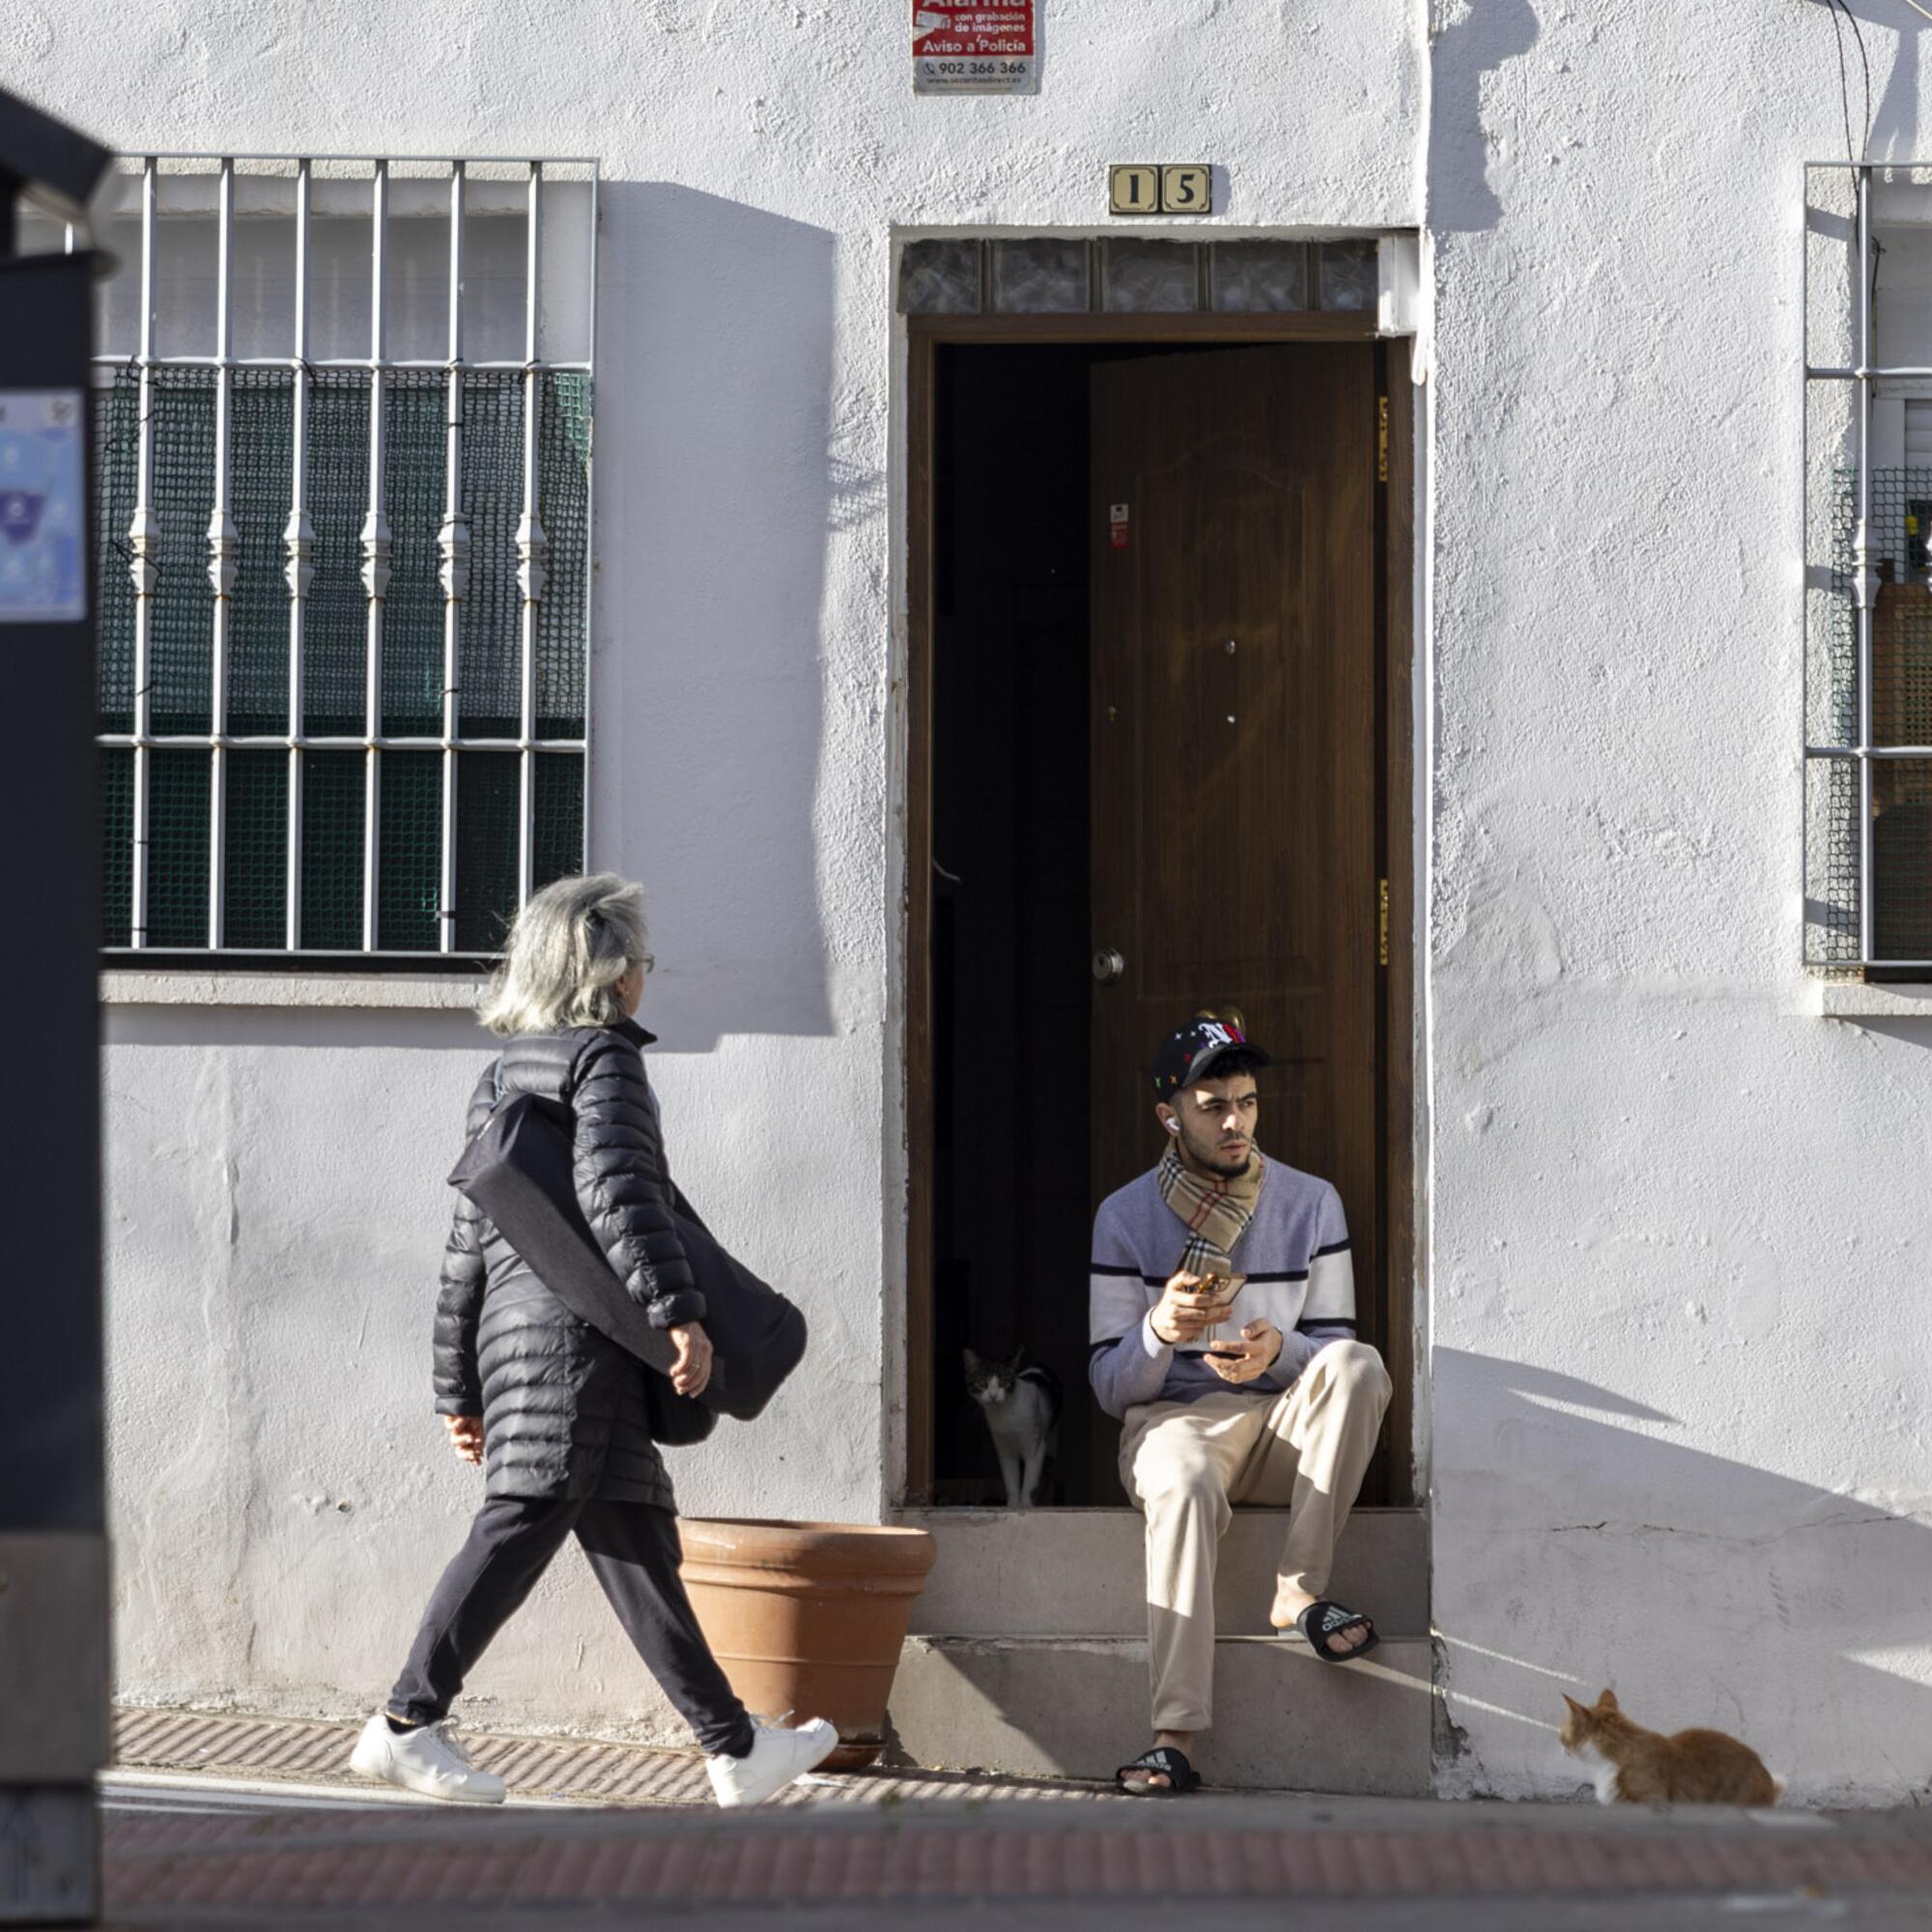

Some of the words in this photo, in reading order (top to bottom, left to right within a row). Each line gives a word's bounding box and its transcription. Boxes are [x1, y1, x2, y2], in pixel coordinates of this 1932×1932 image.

[975, 12, 1025, 22] grabación
[954, 23, 969, 32] de
[973, 23, 1025, 35] imágenes
[923, 40, 962, 52] Aviso
[967, 43, 975, 52] a
[980, 40, 1026, 52] Policía
[939, 63, 965, 74] 902
[970, 63, 995, 74] 366
[1000, 63, 1026, 74] 366
